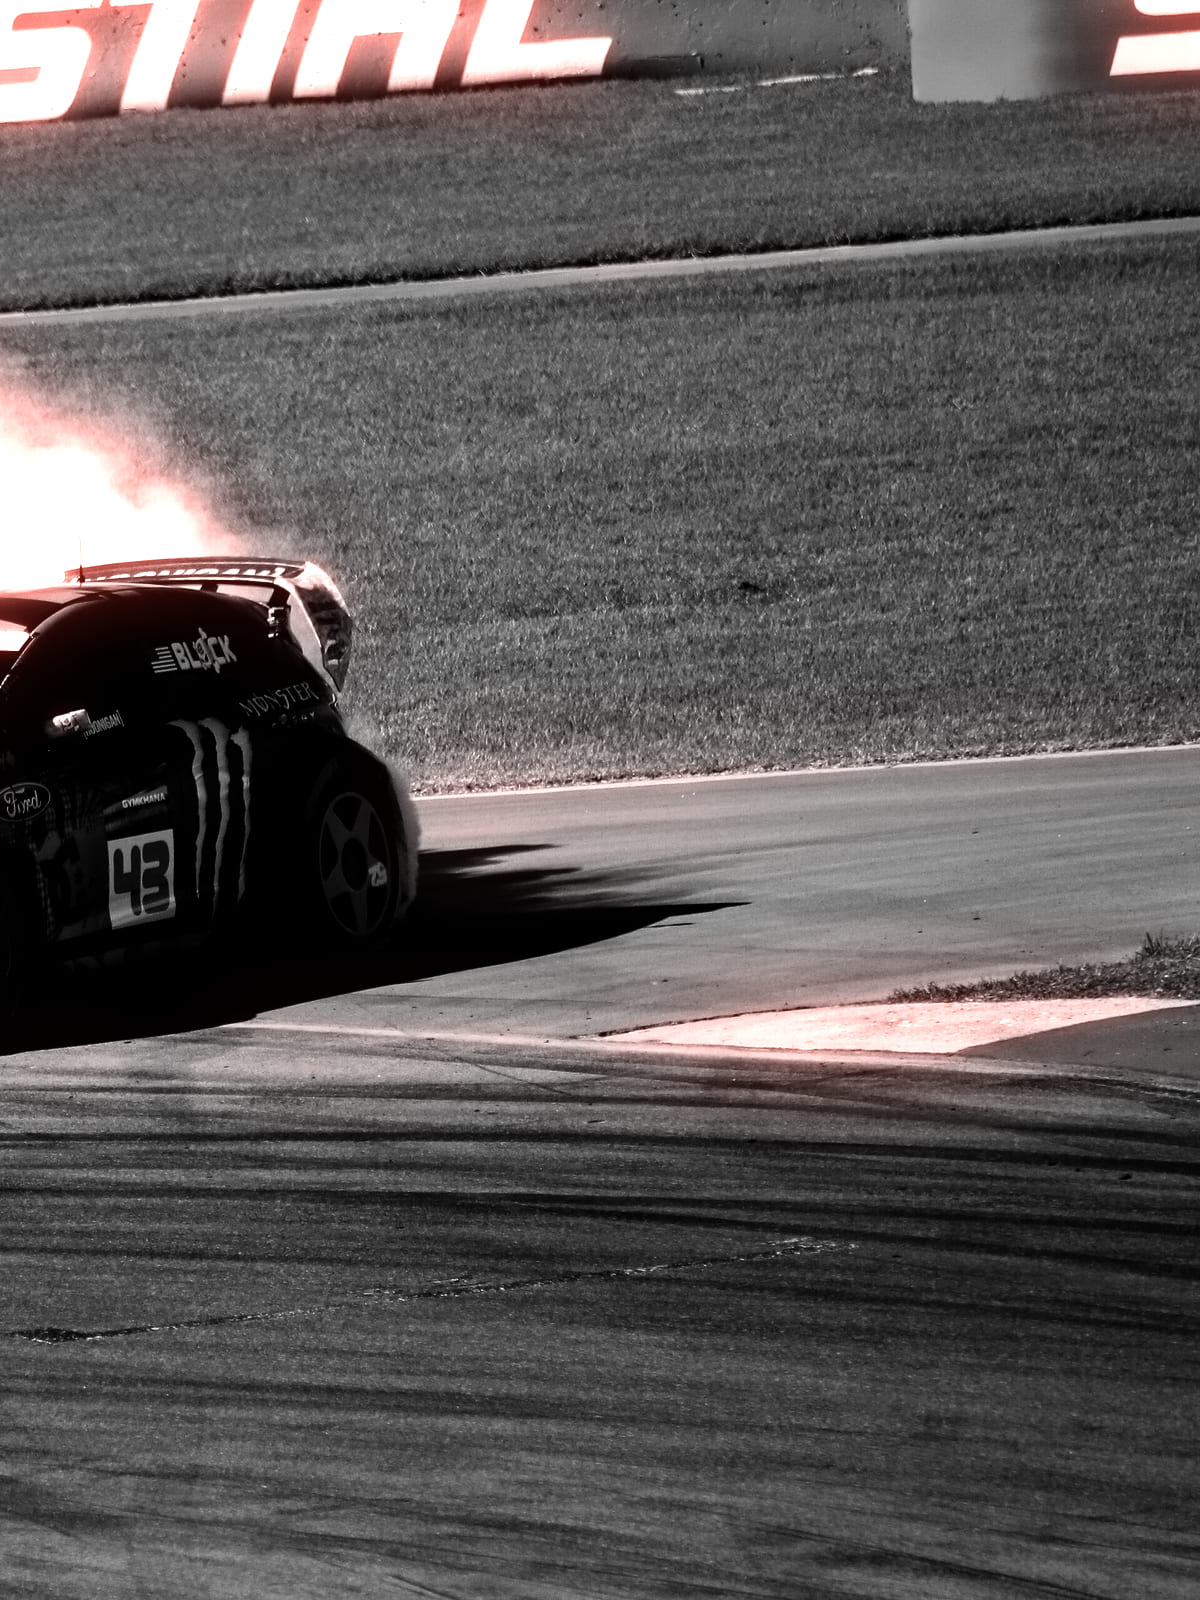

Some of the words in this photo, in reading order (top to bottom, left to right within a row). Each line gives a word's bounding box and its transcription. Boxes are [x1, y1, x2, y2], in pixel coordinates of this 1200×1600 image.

[238, 681, 319, 716] MONSTER
[3, 787, 42, 818] Ford
[121, 792, 166, 808] GYMKHANA
[113, 839, 171, 916] 43
